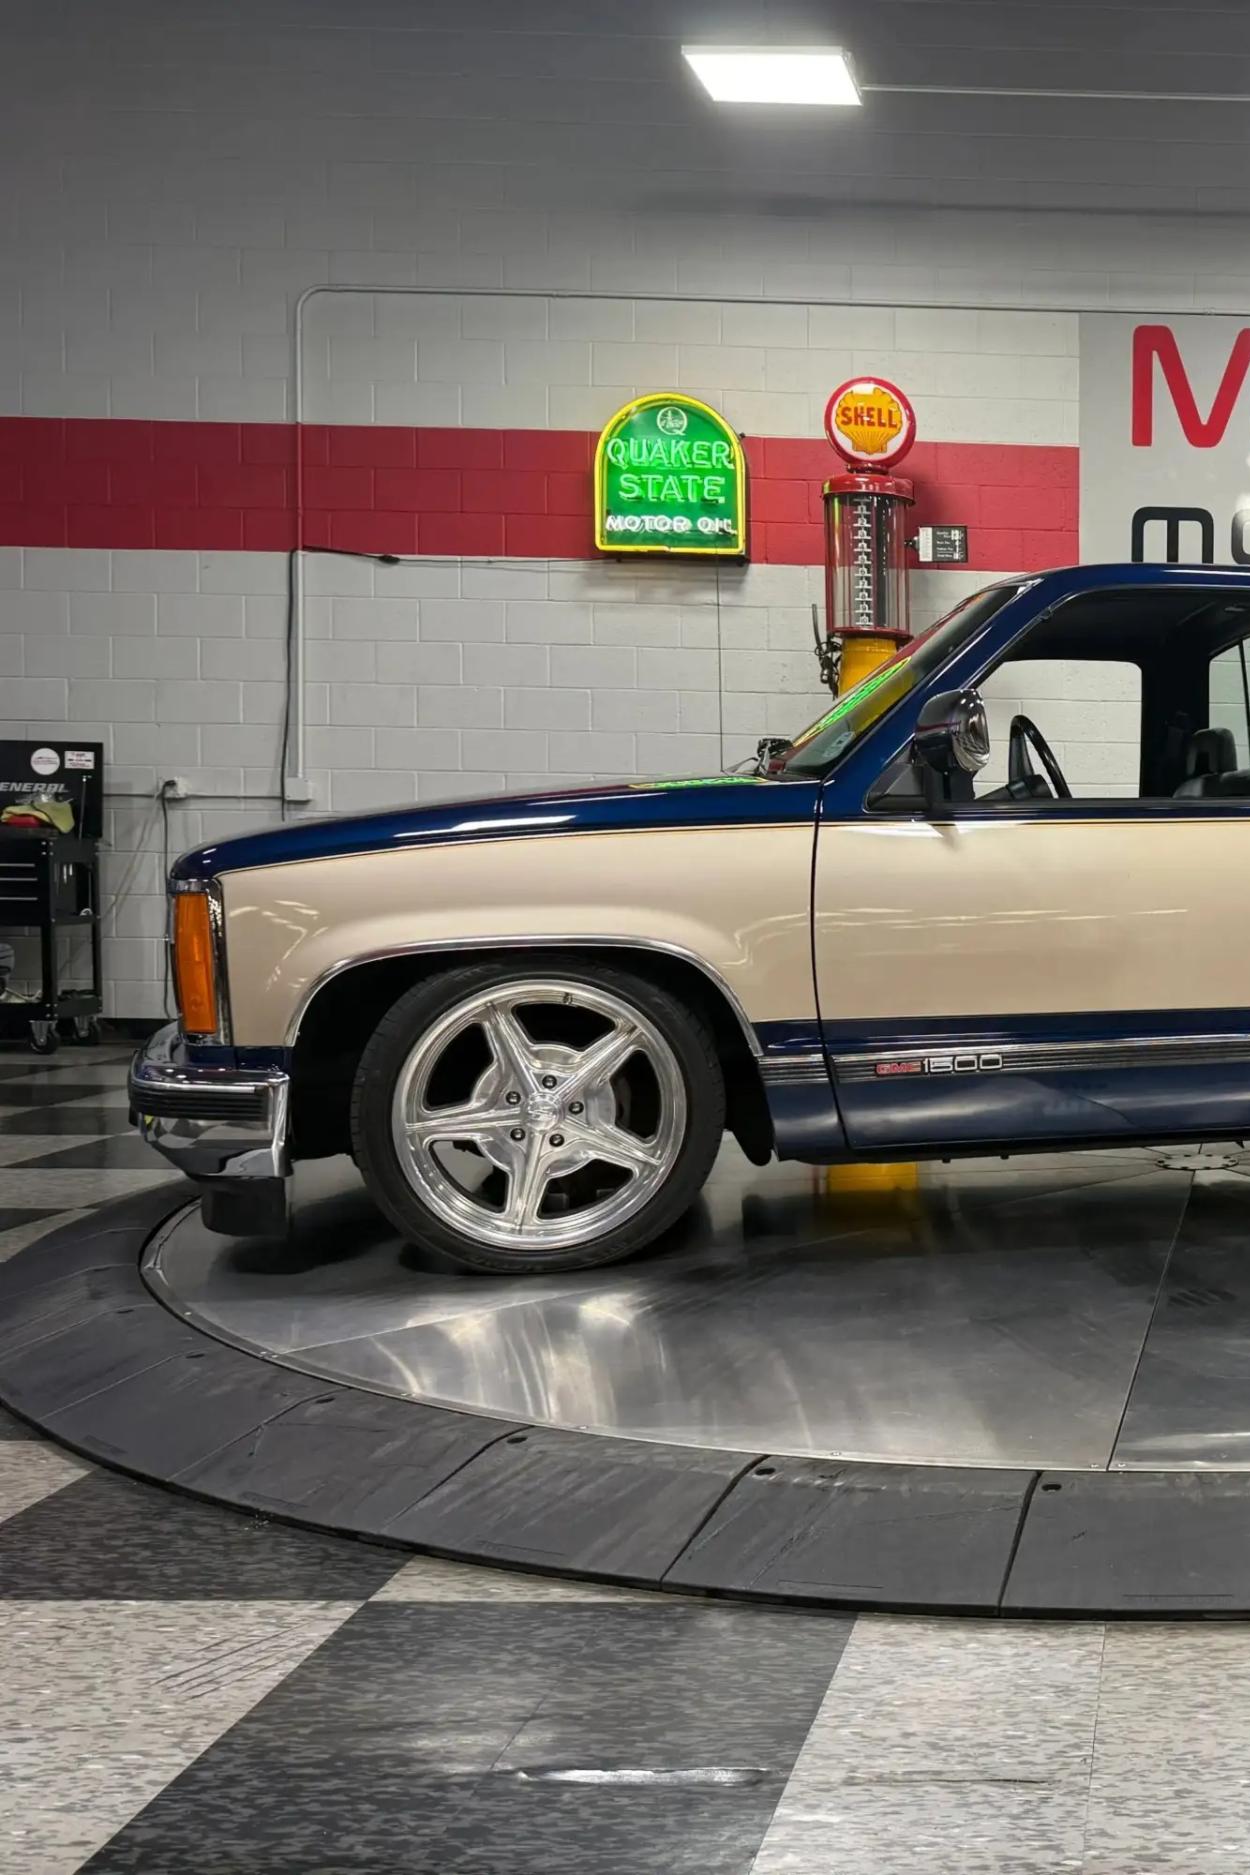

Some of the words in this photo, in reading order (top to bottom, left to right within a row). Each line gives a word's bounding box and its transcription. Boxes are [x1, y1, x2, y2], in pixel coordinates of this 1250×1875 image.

[840, 406, 898, 429] SHELL
[607, 437, 735, 470] QUAKER
[618, 473, 726, 504] STATE
[606, 515, 692, 534] MOTOR
[697, 516, 737, 535] OIL
[0, 782, 68, 792] ENERAL
[876, 1061, 921, 1075] GMC
[923, 1054, 1002, 1073] 1500
